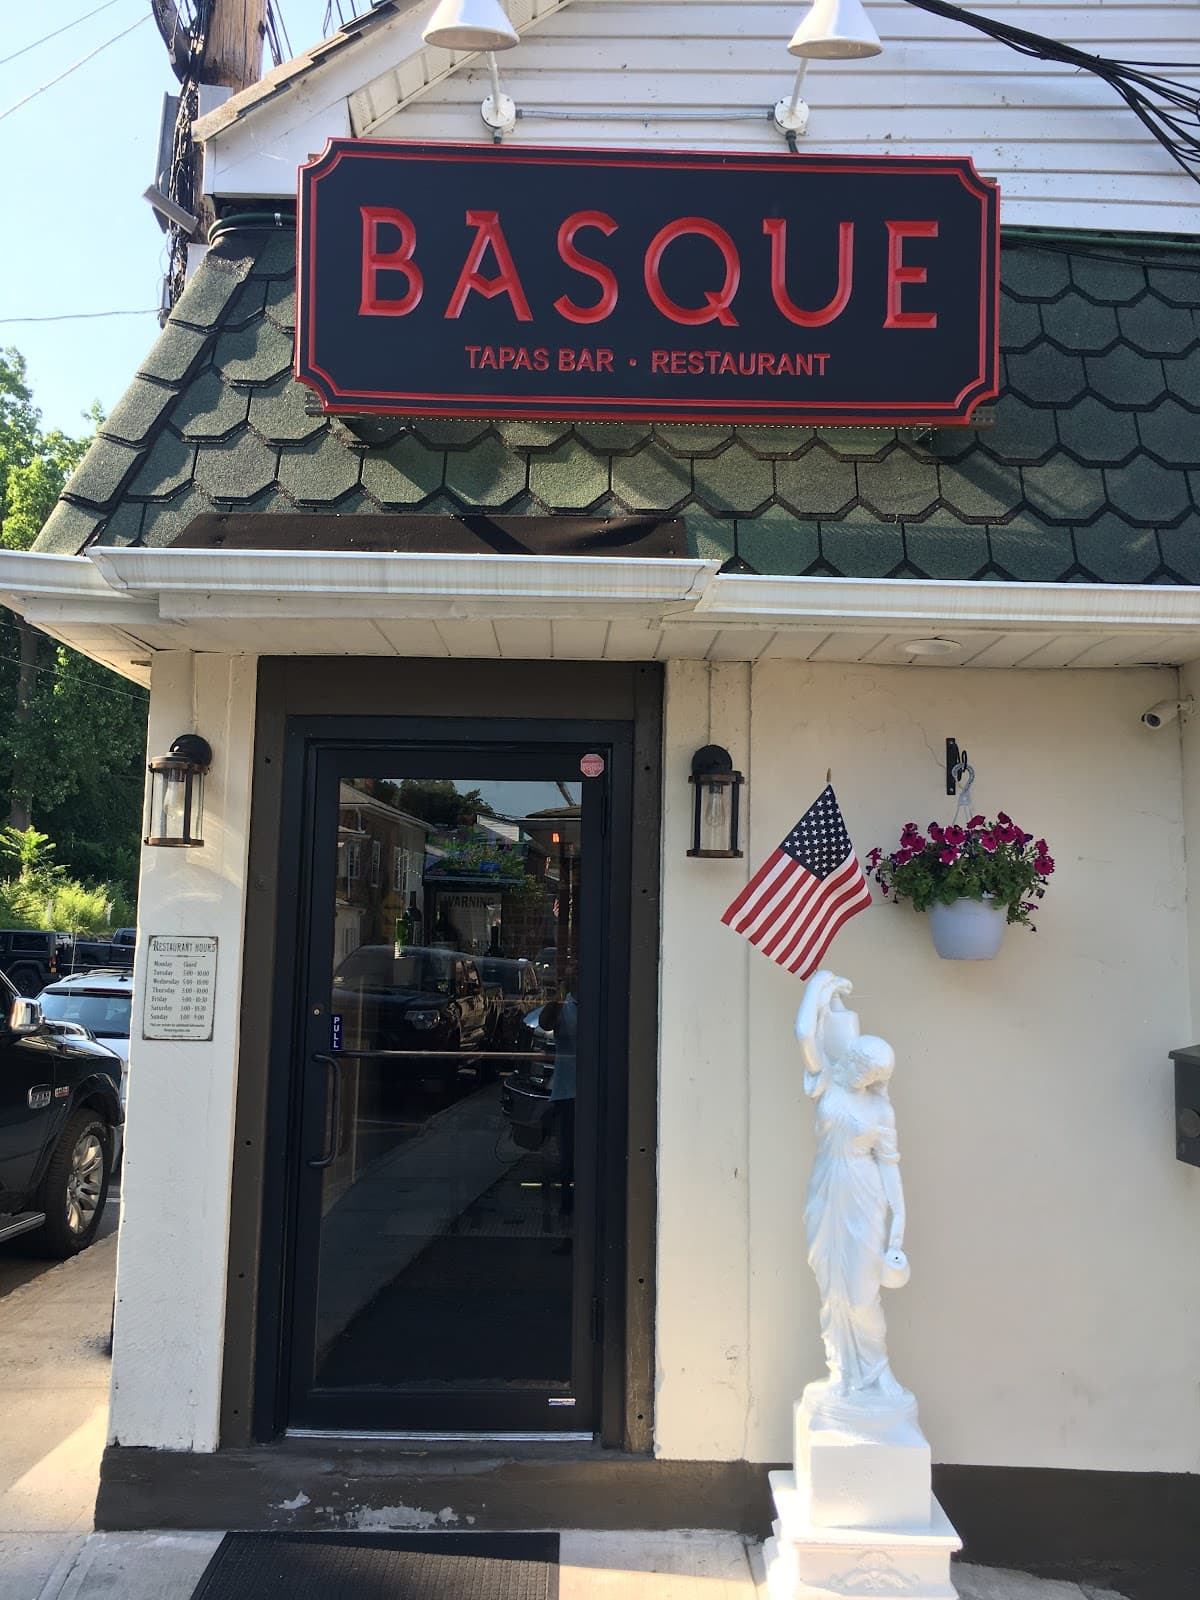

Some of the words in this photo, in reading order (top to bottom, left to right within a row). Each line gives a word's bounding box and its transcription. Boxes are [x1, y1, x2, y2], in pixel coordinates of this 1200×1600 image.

[358, 206, 939, 329] BASQUE
[465, 345, 549, 371] TAPAS
[558, 348, 614, 372] BAR
[651, 350, 831, 376] RESTAURANT
[151, 995, 168, 1003] Friday
